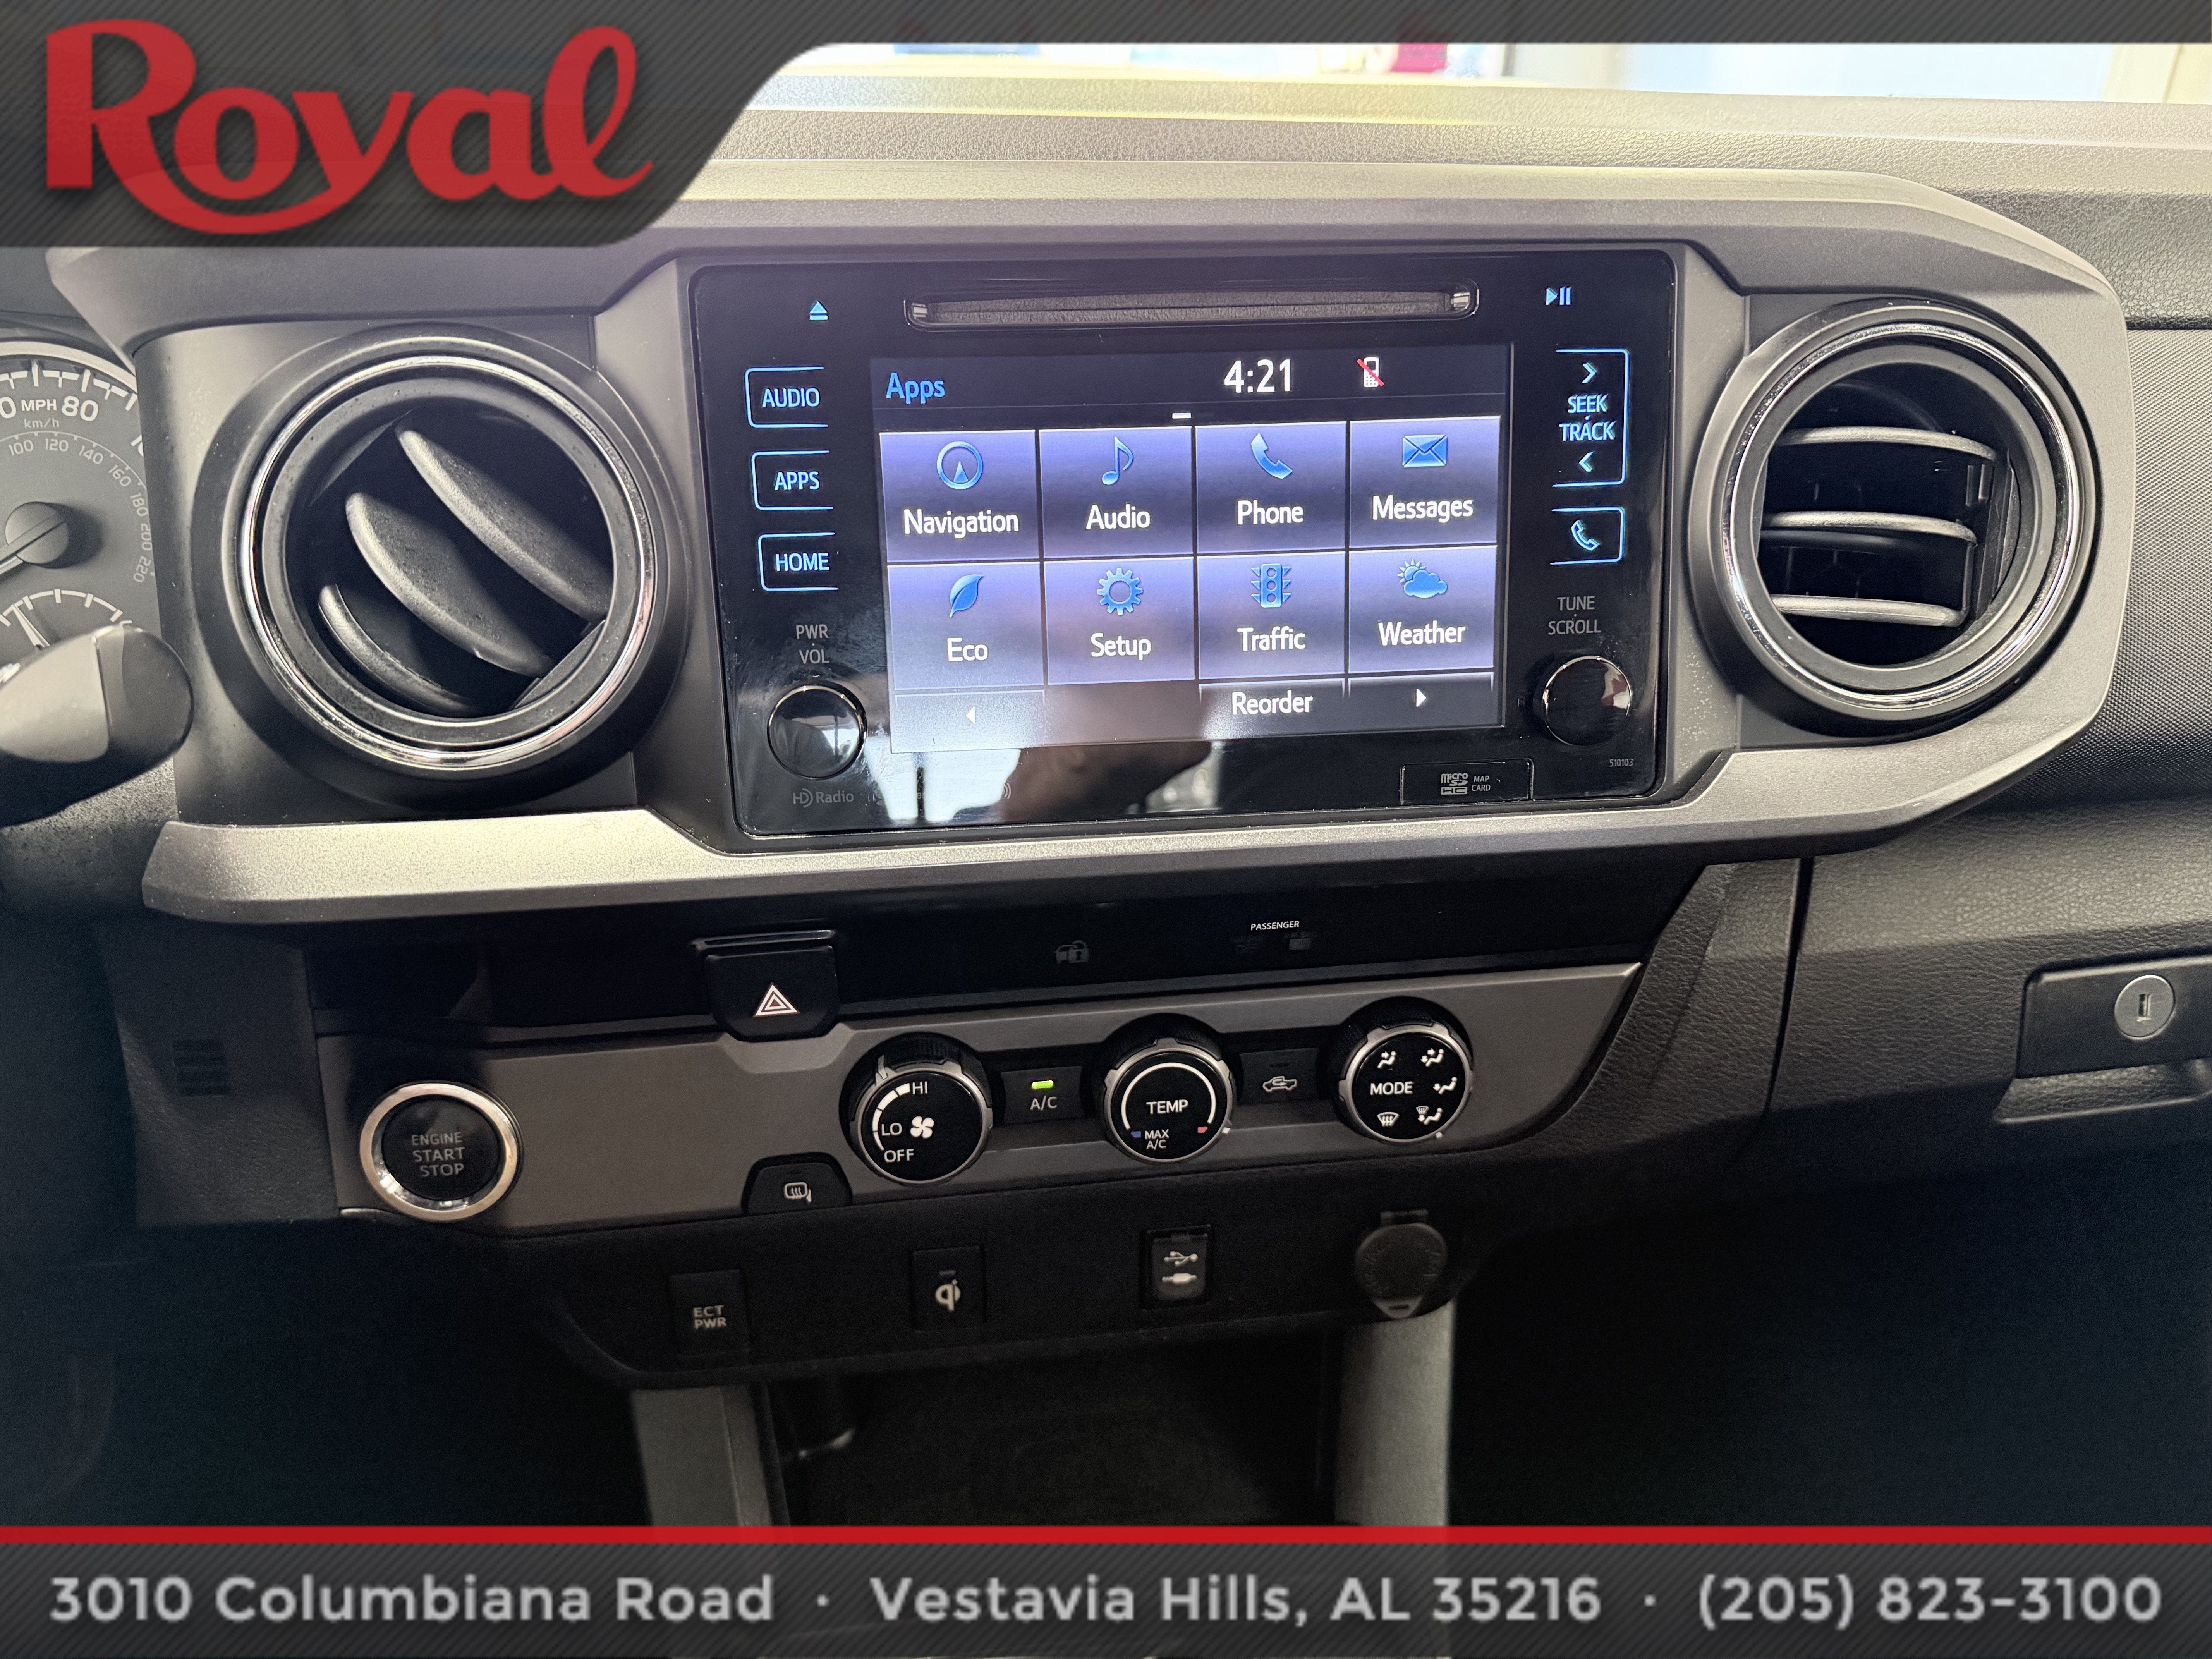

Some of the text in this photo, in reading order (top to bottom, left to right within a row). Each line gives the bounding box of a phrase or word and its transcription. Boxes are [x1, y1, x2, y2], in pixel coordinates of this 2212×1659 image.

[1224, 359, 1291, 393] 4:21
[886, 372, 945, 404] Apps
[21, 399, 57, 411] MPH
[762, 388, 820, 408] AUDIO
[1568, 394, 1608, 413] SEEK
[62, 396, 98, 421] 80
[24, 418, 60, 428] km/h
[1559, 421, 1616, 441] TRACK
[9, 440, 34, 456] 100
[45, 438, 69, 452] 120
[79, 445, 103, 464] 140
[108, 465, 131, 487] 160
[775, 471, 819, 490] APPS
[131, 493, 149, 516] 180
[1238, 500, 1304, 524] Phone
[1372, 495, 1473, 523] Messages
[904, 508, 1019, 539] Navigation
[1086, 504, 1150, 529] Audio
[141, 523, 152, 551] 200
[133, 556, 151, 582] 220
[775, 553, 830, 571] HOME
[1557, 596, 1595, 610] TUNE
[796, 625, 828, 639] PWR
[1378, 620, 1465, 646] Weather
[1548, 619, 1601, 635] SCROLL
[1091, 633, 1151, 660] Setup
[1237, 626, 1306, 651] Traffic
[799, 649, 829, 664] VOL
[947, 637, 988, 662] Eco
[1232, 690, 1313, 715] Reorder
[1609, 759, 1633, 767] 510103
[816, 790, 854, 804] Radio
[1250, 921, 1300, 931] PASSENGER
[912, 1082, 928, 1094] HI
[1370, 1081, 1413, 1095] MODE
[1030, 1096, 1057, 1110] A/C
[1146, 1099, 1188, 1115] TEMP
[881, 1122, 902, 1137] LO
[1144, 1128, 1169, 1139] MAX
[411, 1132, 463, 1146] ENGINE
[1146, 1139, 1166, 1150] A/C
[412, 1147, 465, 1162] START
[884, 1149, 914, 1163] OFF
[419, 1163, 465, 1176] STOP
[694, 1305, 724, 1317] ECT
[694, 1317, 726, 1329] PWR
